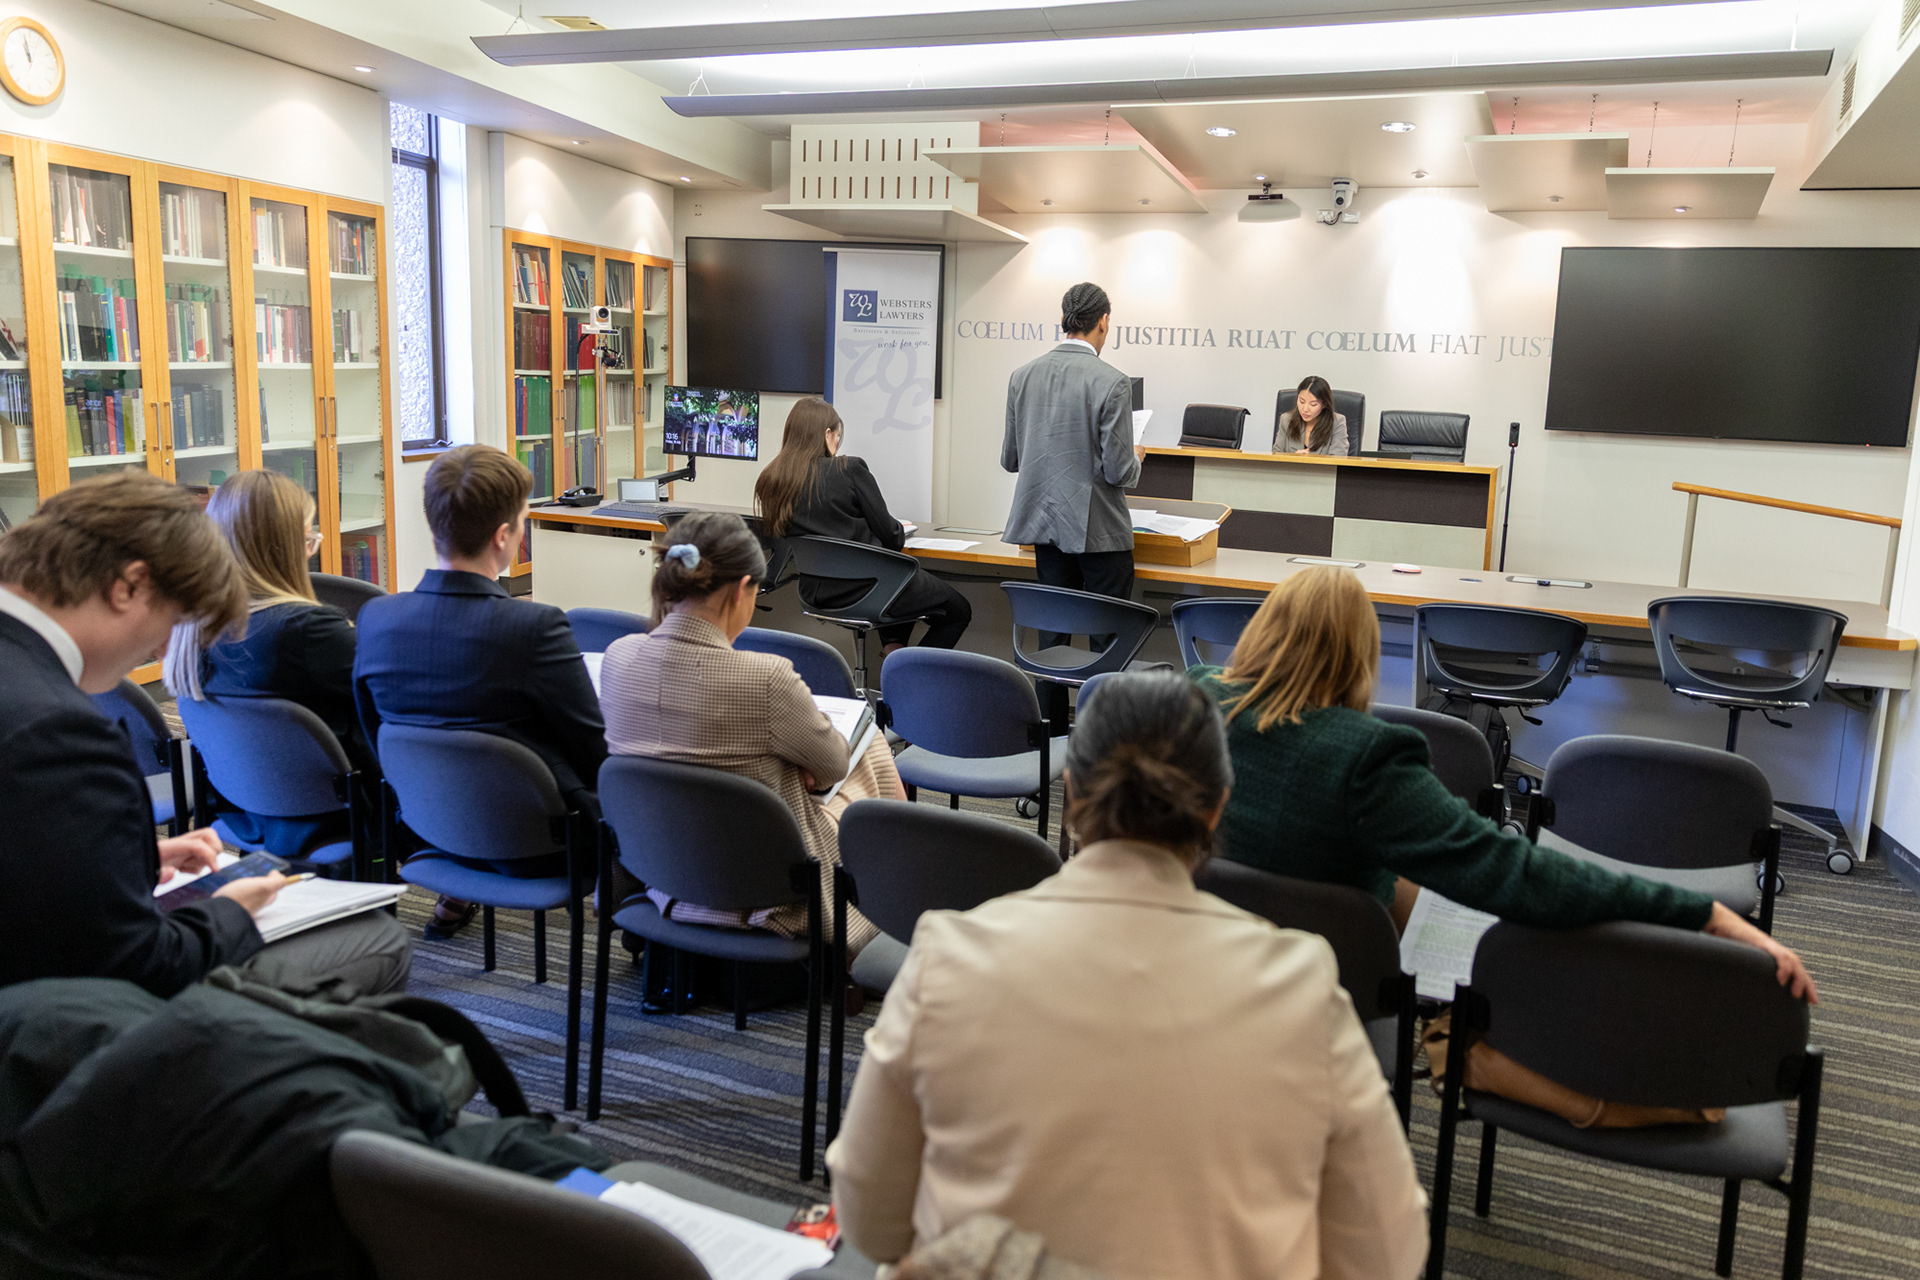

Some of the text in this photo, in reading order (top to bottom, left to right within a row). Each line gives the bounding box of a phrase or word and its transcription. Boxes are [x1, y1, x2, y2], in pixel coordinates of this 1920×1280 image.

[879, 299, 932, 309] WEBSTERS
[879, 311, 925, 320] LAWYERS
[877, 339, 898, 349] work
[899, 338, 912, 349] for
[1112, 325, 1218, 350] JUSTITIA
[1226, 328, 1297, 350] RUAT
[1430, 333, 1487, 355] FIAT
